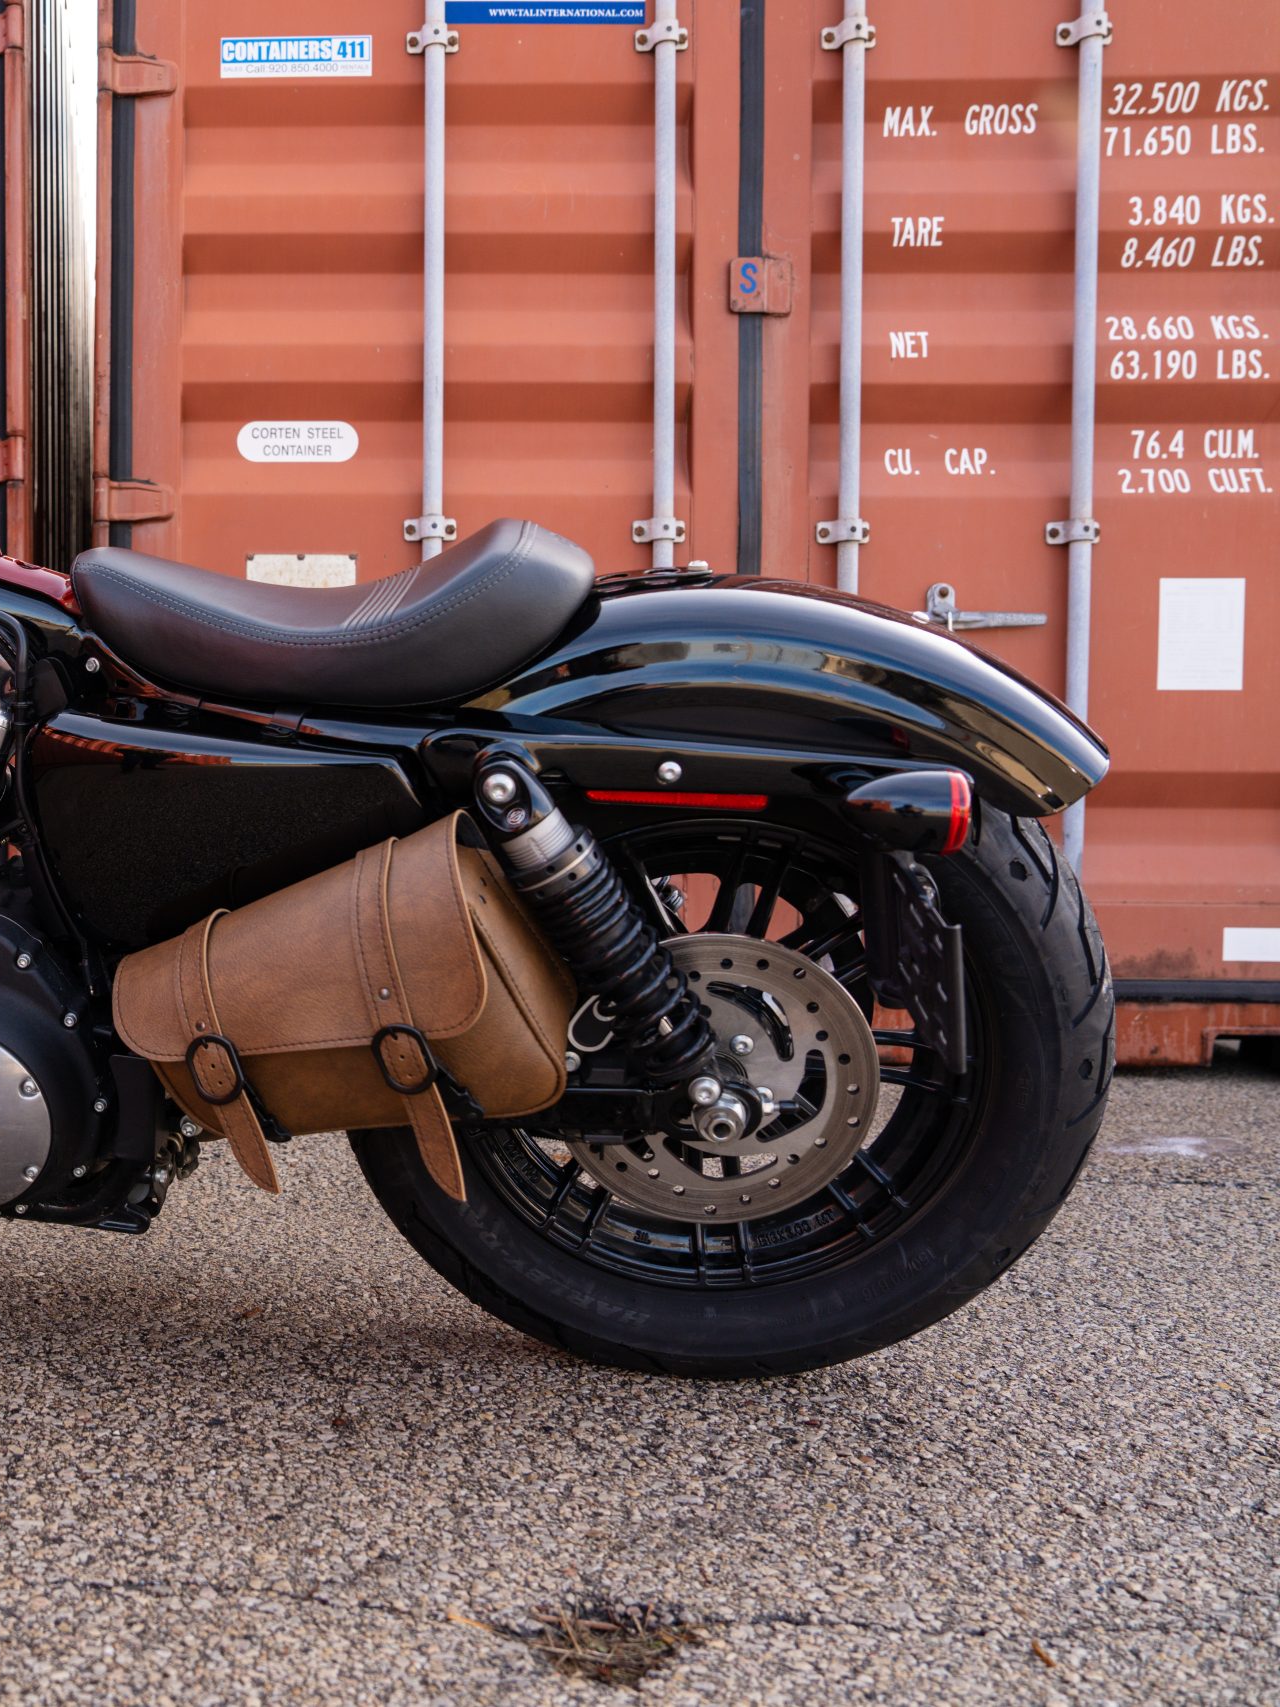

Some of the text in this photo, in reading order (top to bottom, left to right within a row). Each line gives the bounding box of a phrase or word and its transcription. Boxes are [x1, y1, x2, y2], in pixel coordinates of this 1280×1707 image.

[489, 8, 644, 17] WWW.TALINTERNATIONAL.COM
[222, 41, 365, 62] CONTAINERS 411
[1108, 79, 1270, 115] 32,500 KGS.
[883, 103, 1039, 137] MAX. GROSS
[1104, 123, 1265, 157] 71,650 LBS.
[1128, 194, 1275, 226] 3,840 KGS.
[891, 216, 945, 247] TARE
[1121, 236, 1265, 268] 8,460 LBS.
[739, 263, 758, 294] S
[1105, 315, 1269, 340] 28,660 KGS.
[889, 331, 929, 359] NET
[1110, 349, 1270, 380] 63,190 LBS.
[251, 427, 344, 439] CORTEN STEEL
[1130, 429, 1260, 459] 76.4 CU.M.
[262, 445, 332, 456] CONTAINER
[884, 448, 996, 476] CU. CAP.
[1117, 468, 1191, 493] 2,700
